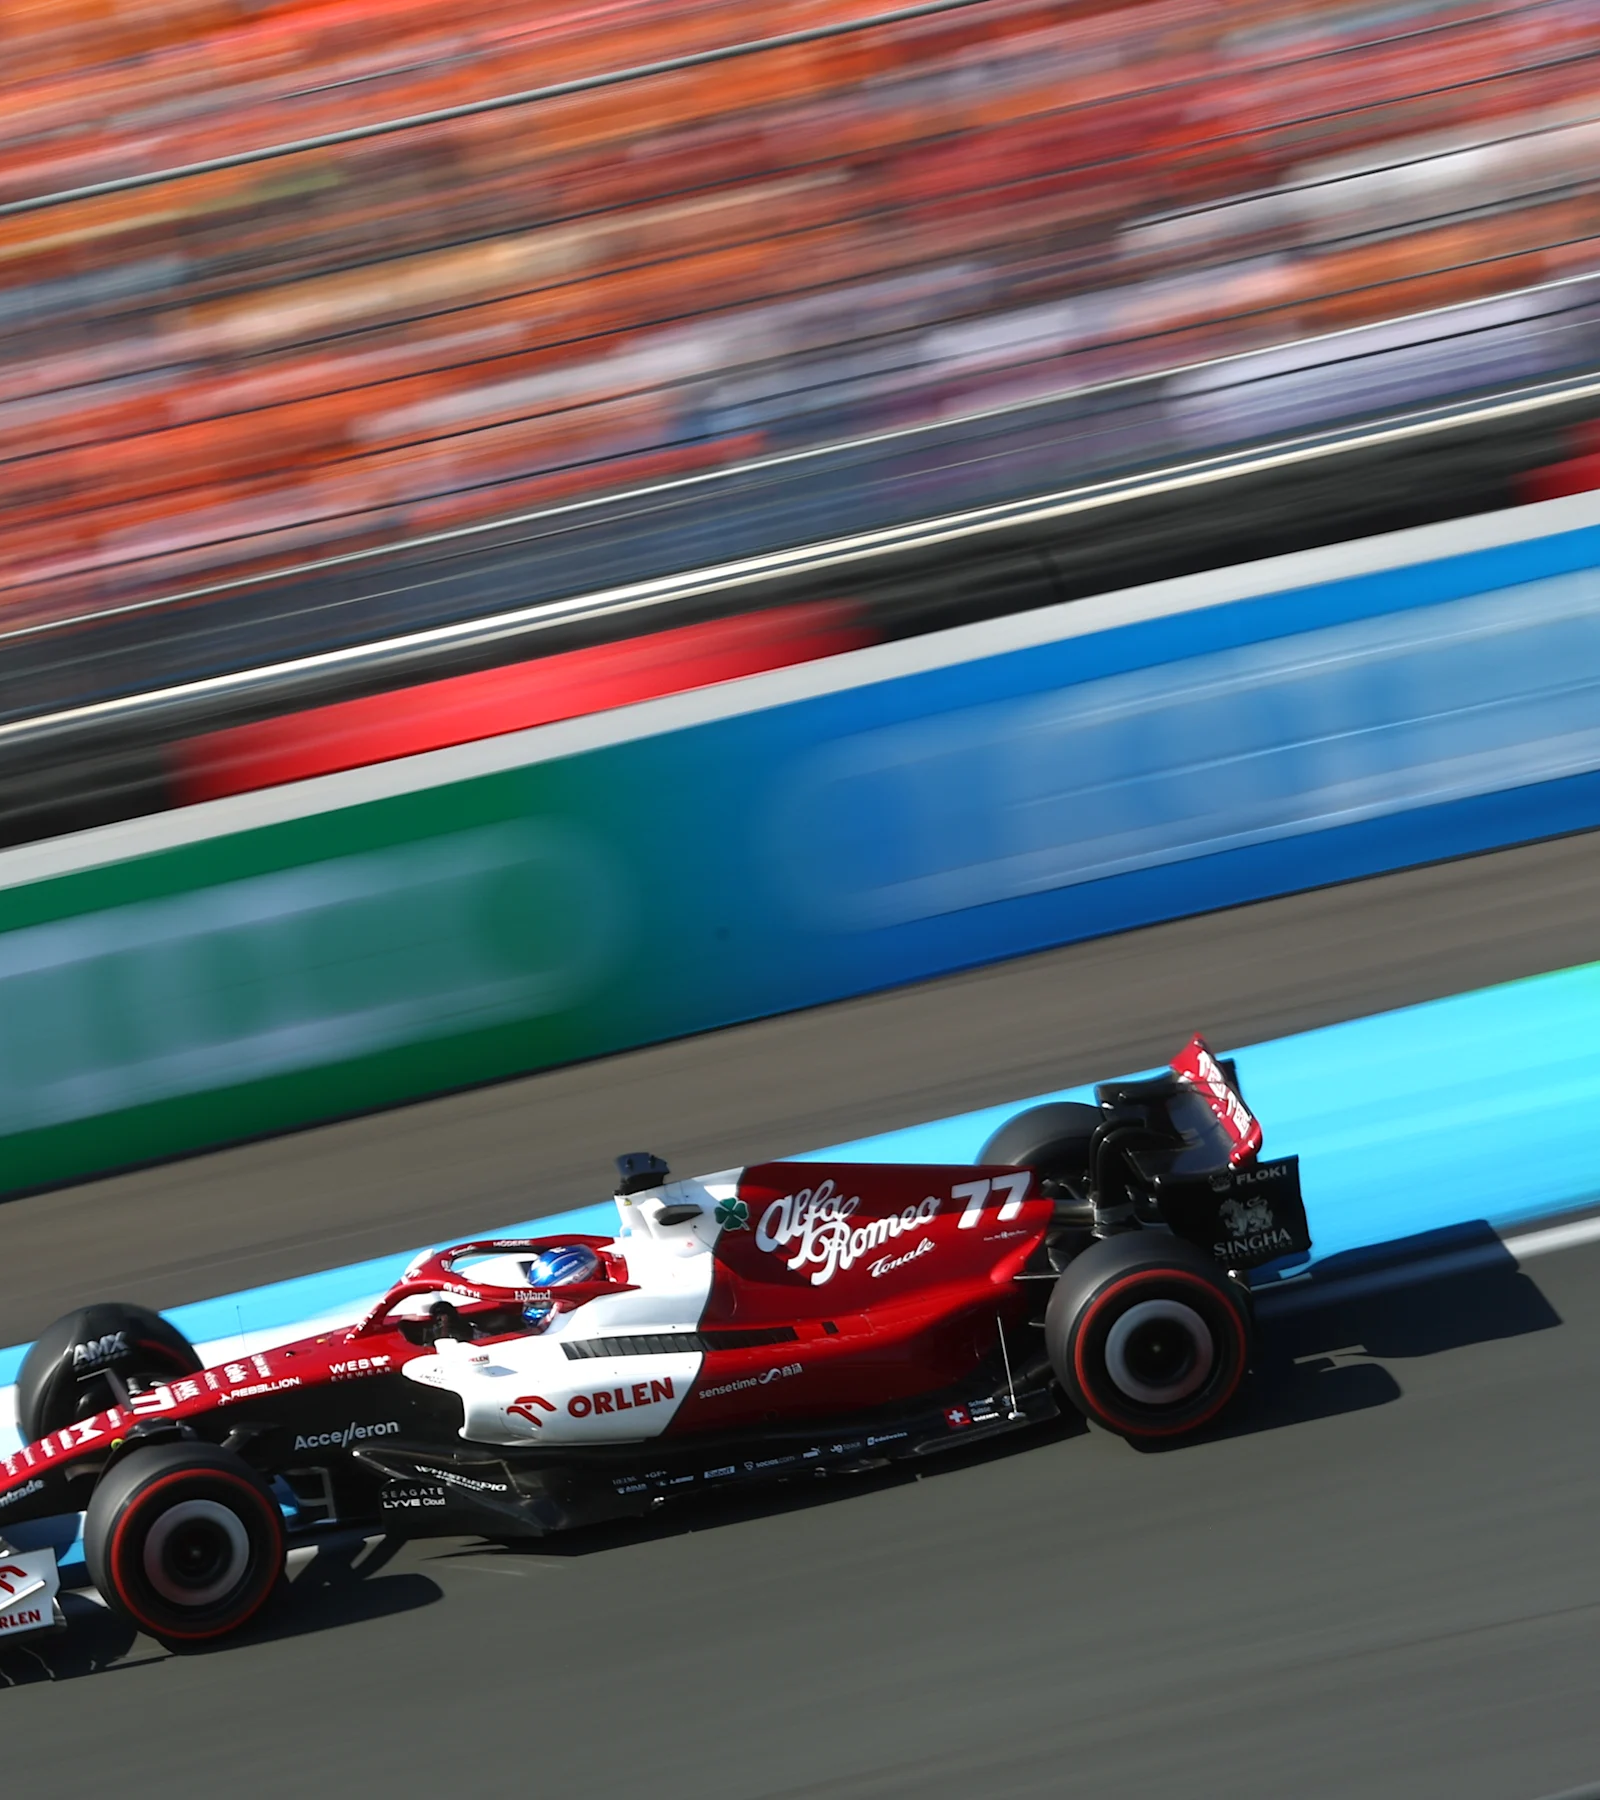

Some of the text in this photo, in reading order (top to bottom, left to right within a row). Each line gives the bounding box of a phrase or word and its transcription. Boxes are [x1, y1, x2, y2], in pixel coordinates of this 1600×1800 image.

[1236, 1165, 1287, 1185] FLOKI
[951, 1171, 1033, 1229] 77
[755, 1179, 860, 1252] Alfa
[787, 1196, 941, 1285] Romeo
[1214, 1228, 1291, 1257] SINGHA
[866, 1237, 935, 1277] Tonale
[514, 1290, 551, 1302] Hyland
[73, 1331, 127, 1365] AMX
[329, 1358, 370, 1374] WEB
[331, 1367, 391, 1382] EYEWEAR
[231, 1376, 301, 1399] REBELLION
[567, 1376, 675, 1419] ORLEN
[699, 1377, 757, 1399] sensetime
[755, 1456, 796, 1468] socios.com
[382, 1487, 444, 1499] SEAGATE
[383, 1499, 420, 1508] LYVE
